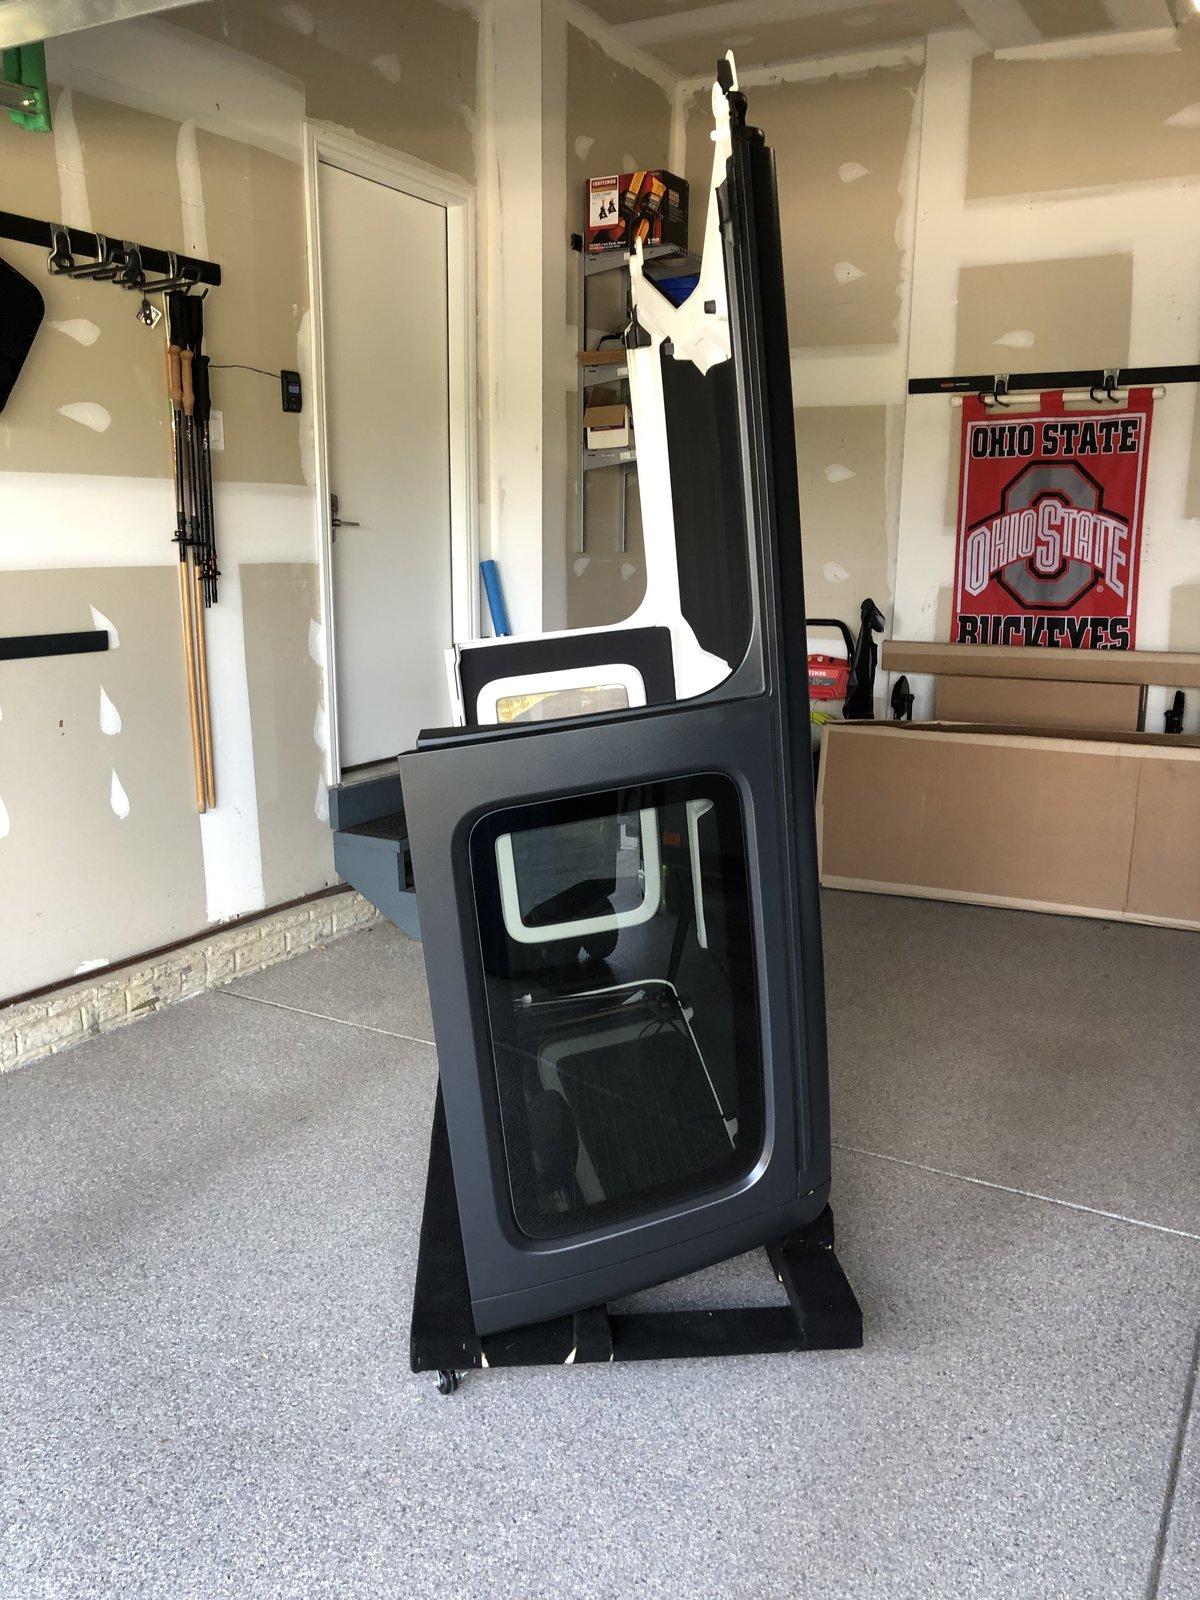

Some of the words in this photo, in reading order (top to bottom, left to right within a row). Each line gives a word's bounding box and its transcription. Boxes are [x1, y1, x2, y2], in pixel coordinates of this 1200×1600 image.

[592, 179, 616, 187] CRAFTSMAN
[971, 424, 1035, 459] OHIO
[1041, 419, 1138, 456] STATE
[965, 509, 1037, 597] OHIO
[1036, 499, 1128, 598] STATE
[957, 614, 1130, 650] BUCKEYES
